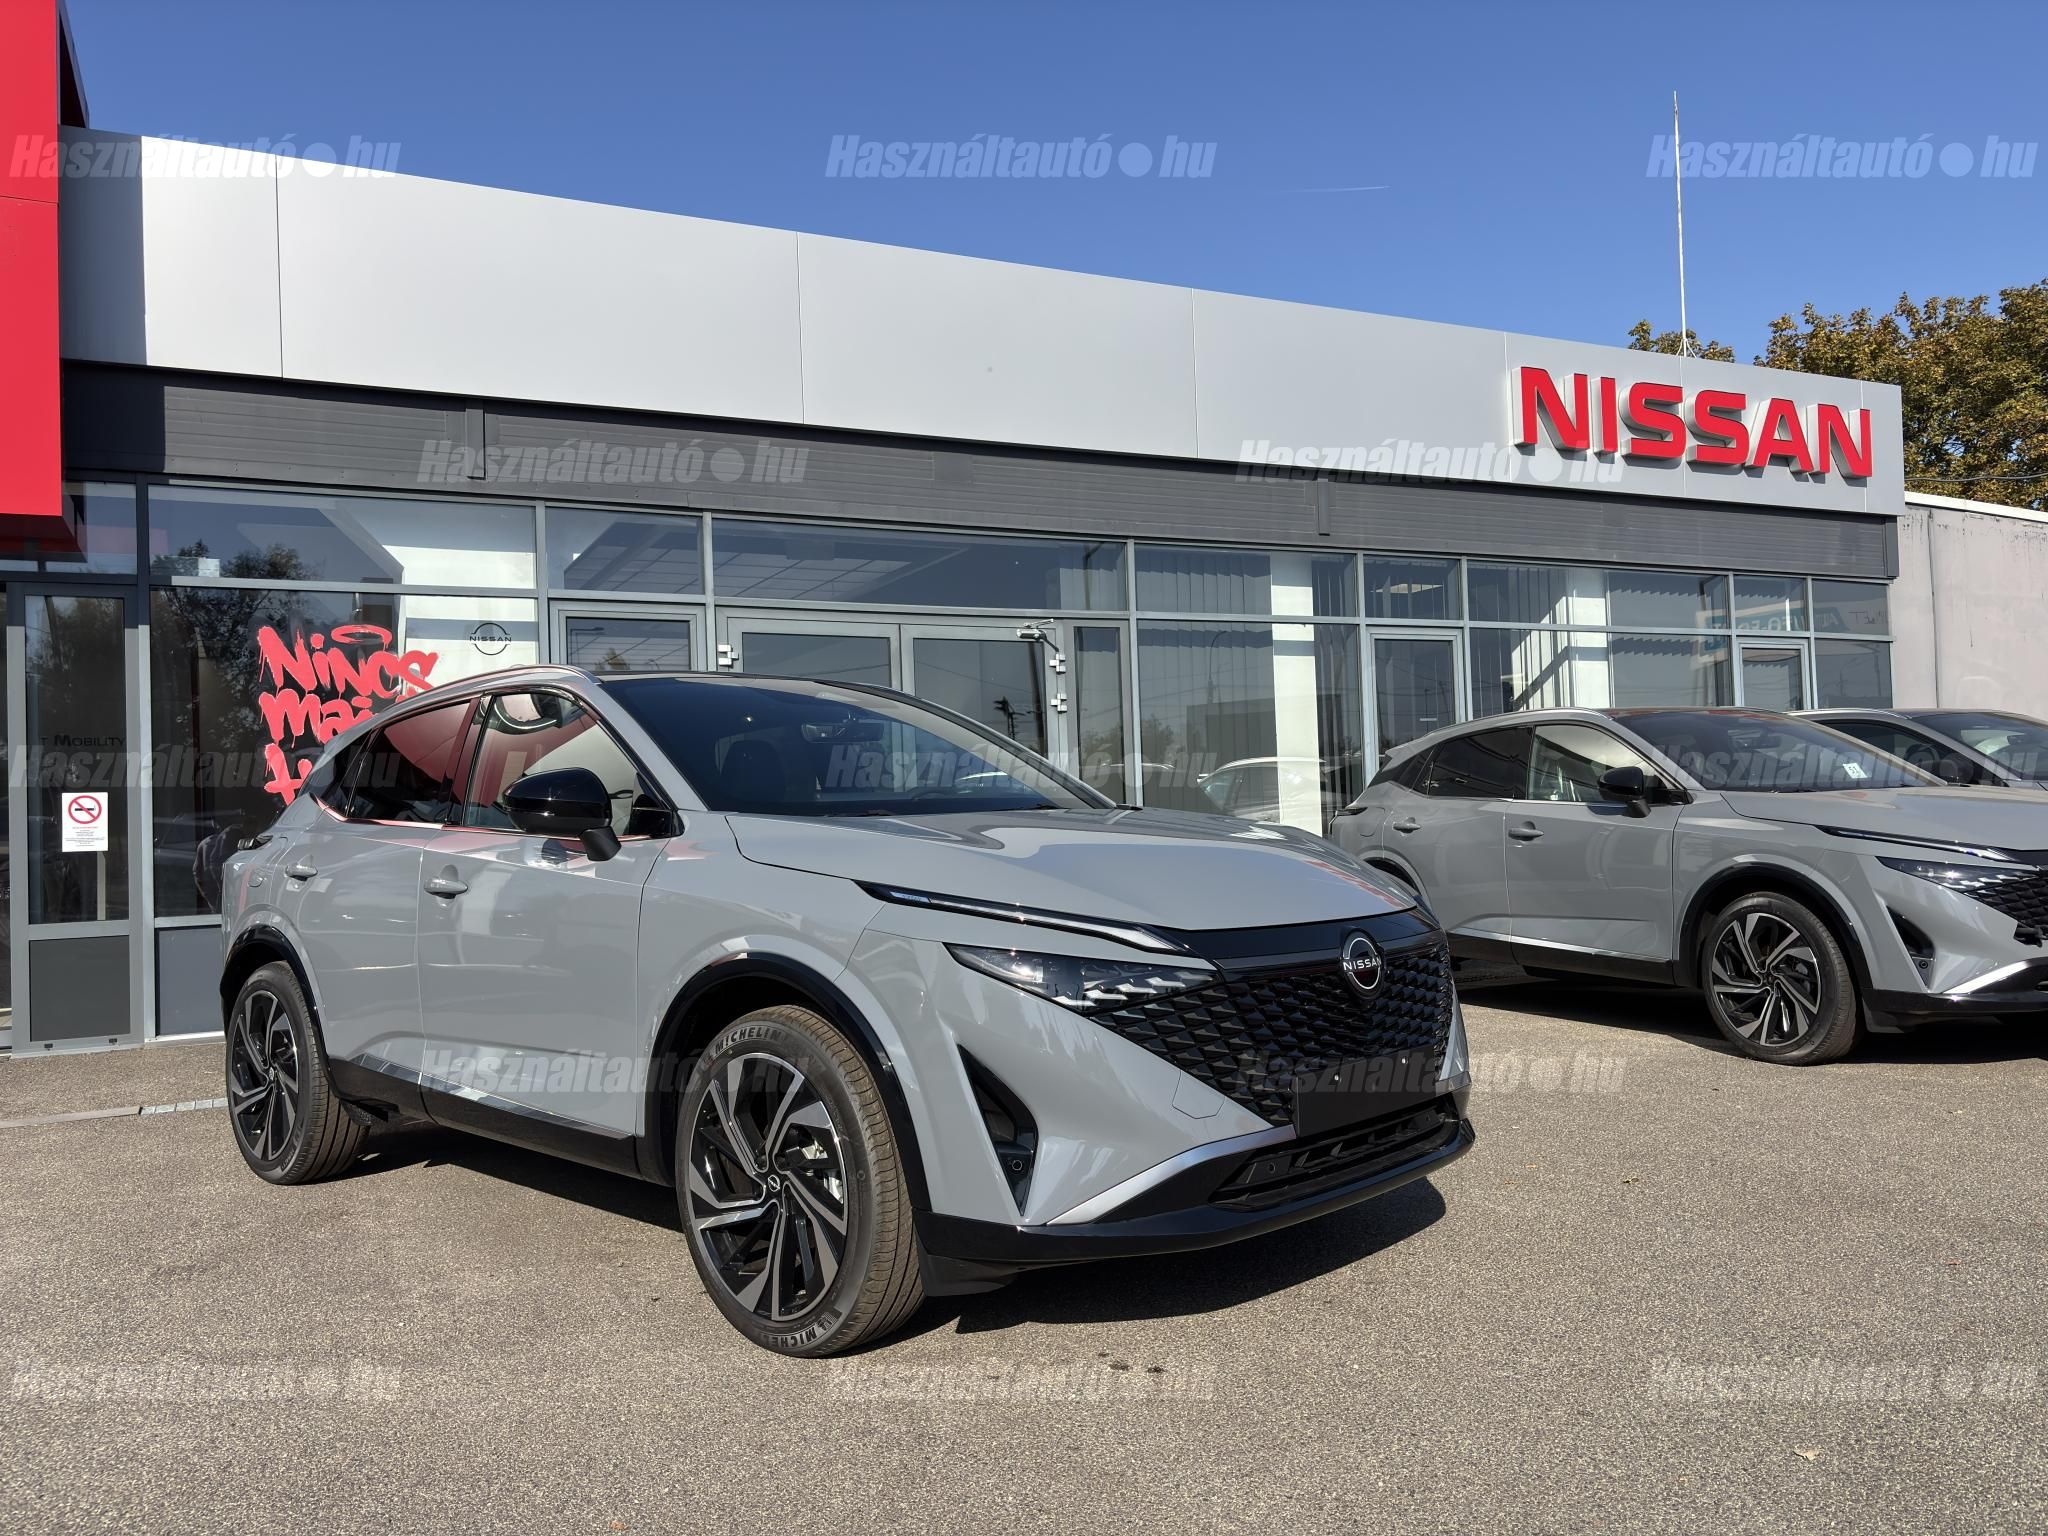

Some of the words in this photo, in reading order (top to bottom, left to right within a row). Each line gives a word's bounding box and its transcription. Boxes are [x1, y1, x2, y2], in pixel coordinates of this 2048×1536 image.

[1514, 366, 1872, 478] NISSAN
[469, 634, 512, 643] NISSAN
[54, 734, 126, 747] MOBILITY
[1342, 955, 1382, 971] NISSAN
[715, 1026, 781, 1054] MICHELIN
